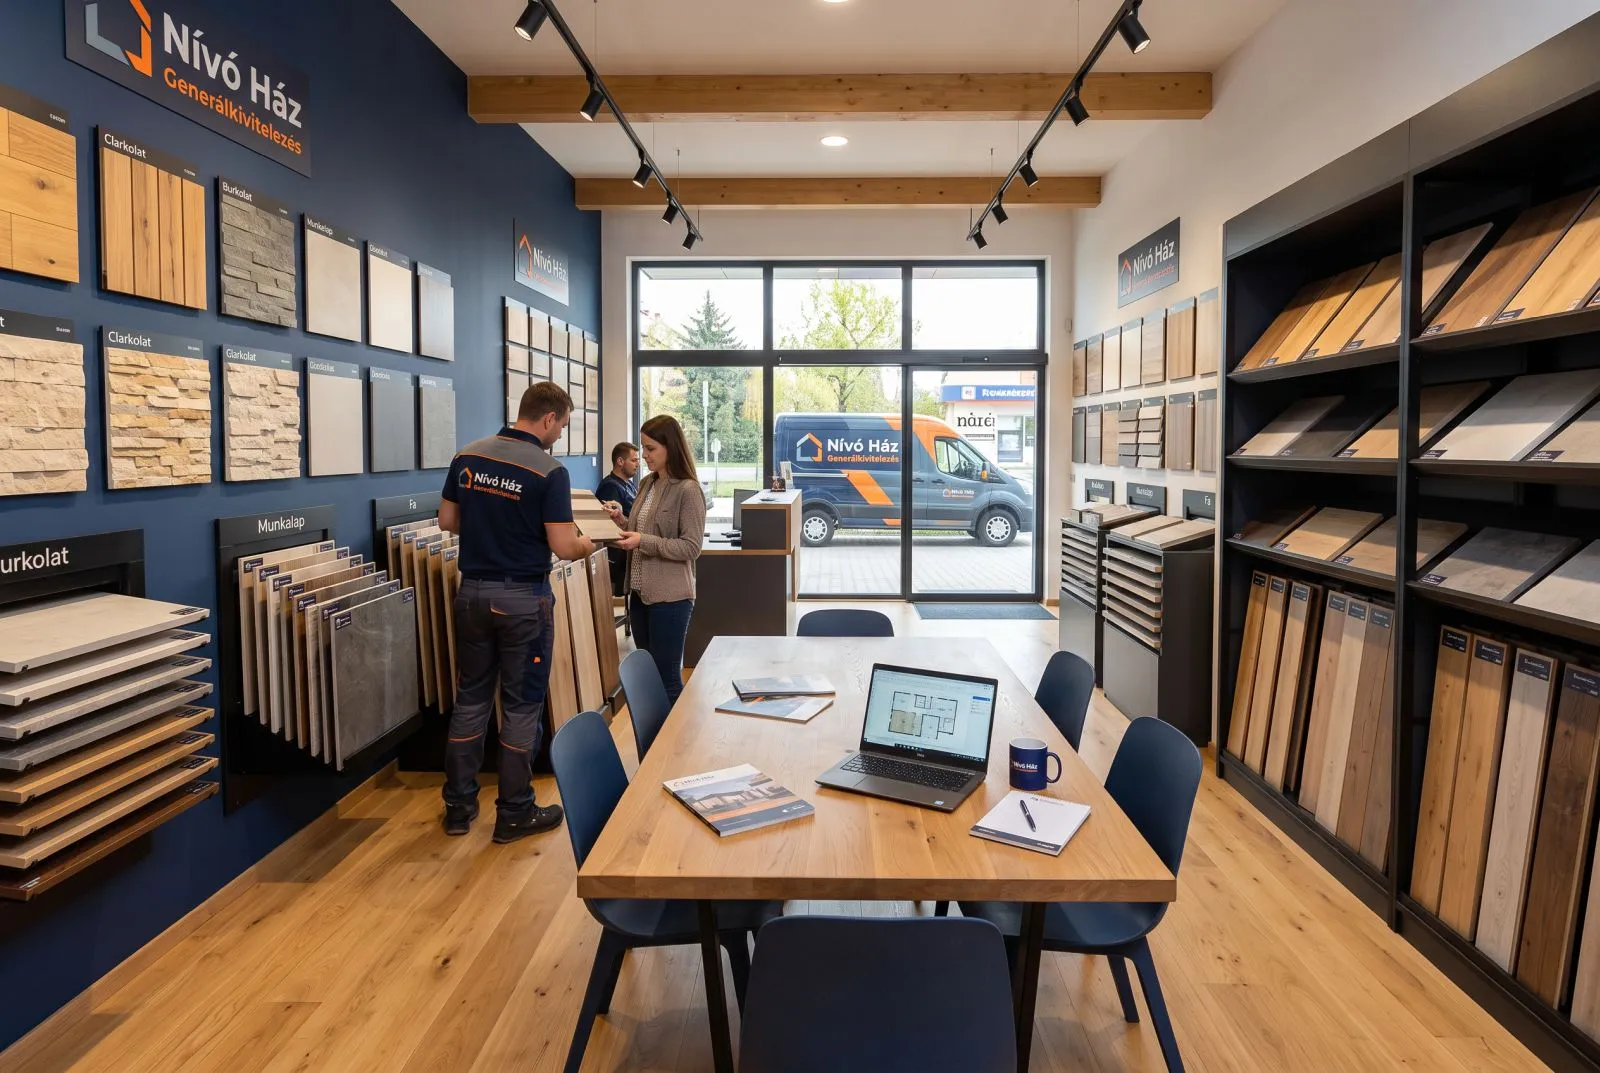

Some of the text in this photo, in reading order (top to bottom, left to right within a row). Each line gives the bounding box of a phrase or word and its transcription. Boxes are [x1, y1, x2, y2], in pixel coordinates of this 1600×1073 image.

[163, 12, 302, 128] Nívó Ház
[163, 67, 302, 154] Generálkivitelezés
[104, 133, 147, 159] Clarkolat
[222, 181, 252, 202] Burkolat
[108, 331, 152, 347] Clarkolat
[827, 438, 899, 453] Nívó Ház
[474, 472, 523, 492] Nívó Ház
[409, 499, 417, 510] Fa
[258, 516, 305, 534] Munkalap
[0, 547, 69, 574] urkolat
